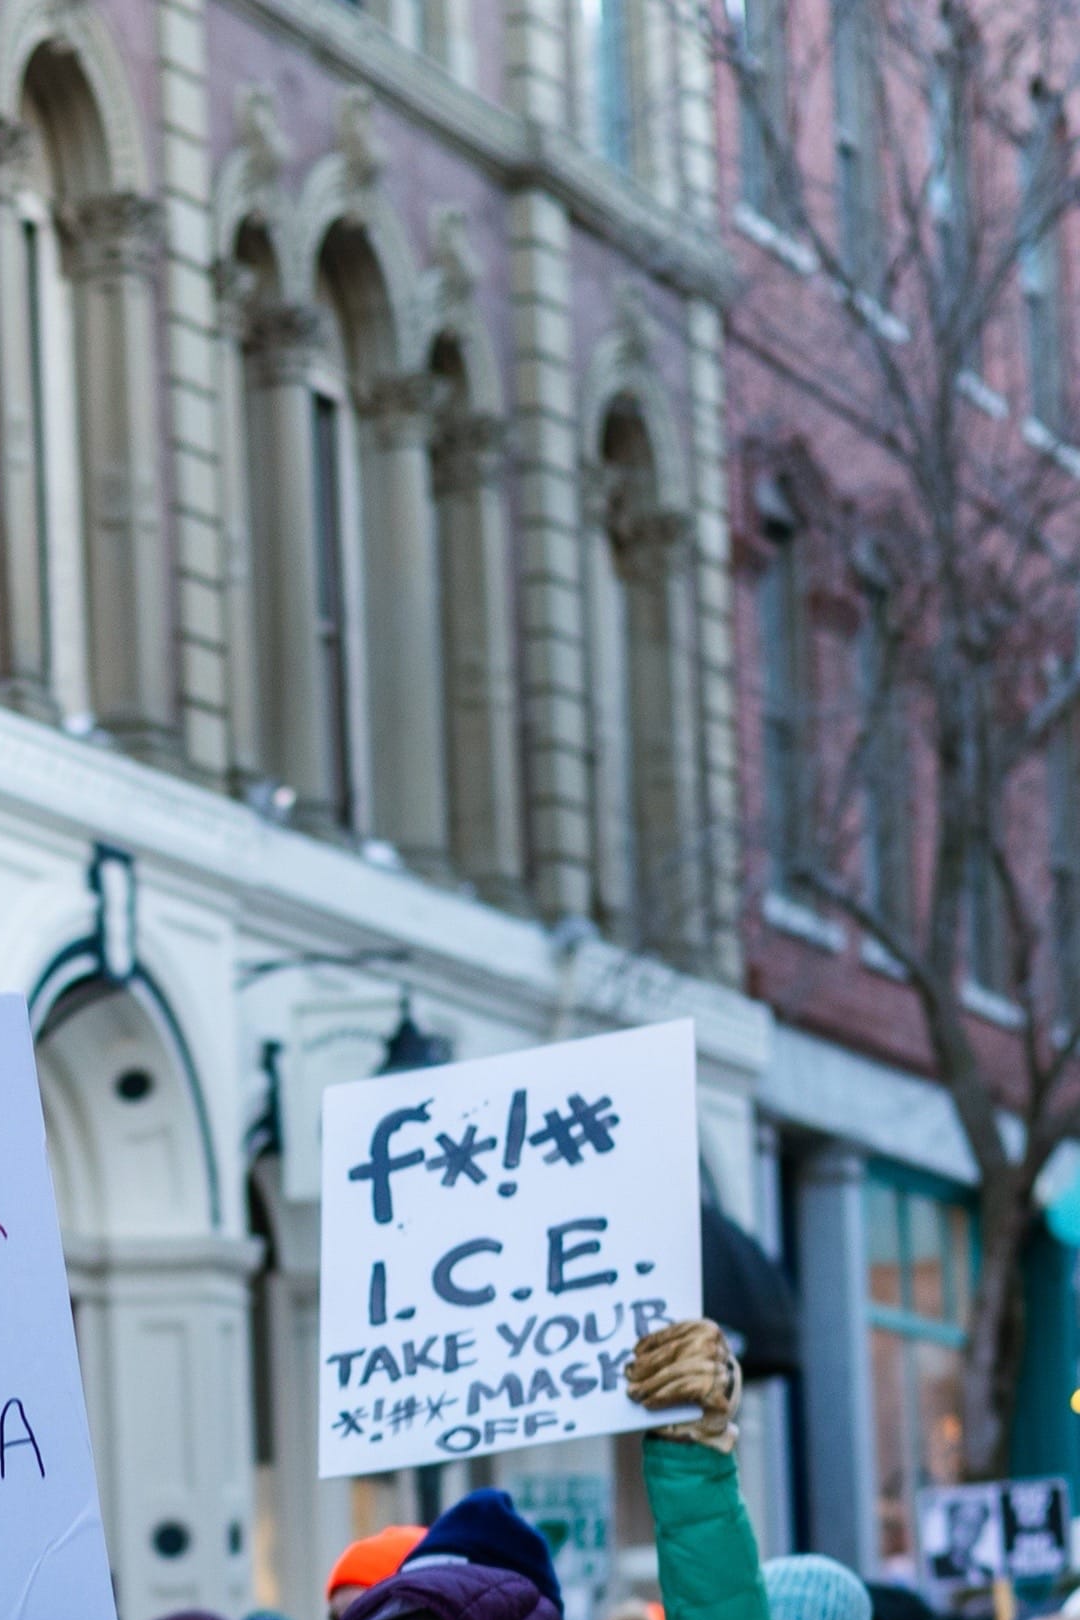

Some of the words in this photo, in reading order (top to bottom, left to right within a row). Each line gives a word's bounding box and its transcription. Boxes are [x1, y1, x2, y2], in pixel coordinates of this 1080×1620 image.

[369, 1216, 655, 1326] I.C.E.
[327, 1328, 478, 1390] TAKE
[495, 1297, 676, 1358] YOUR
[467, 1347, 634, 1416] MASK
[435, 1410, 577, 1454] OFF.
